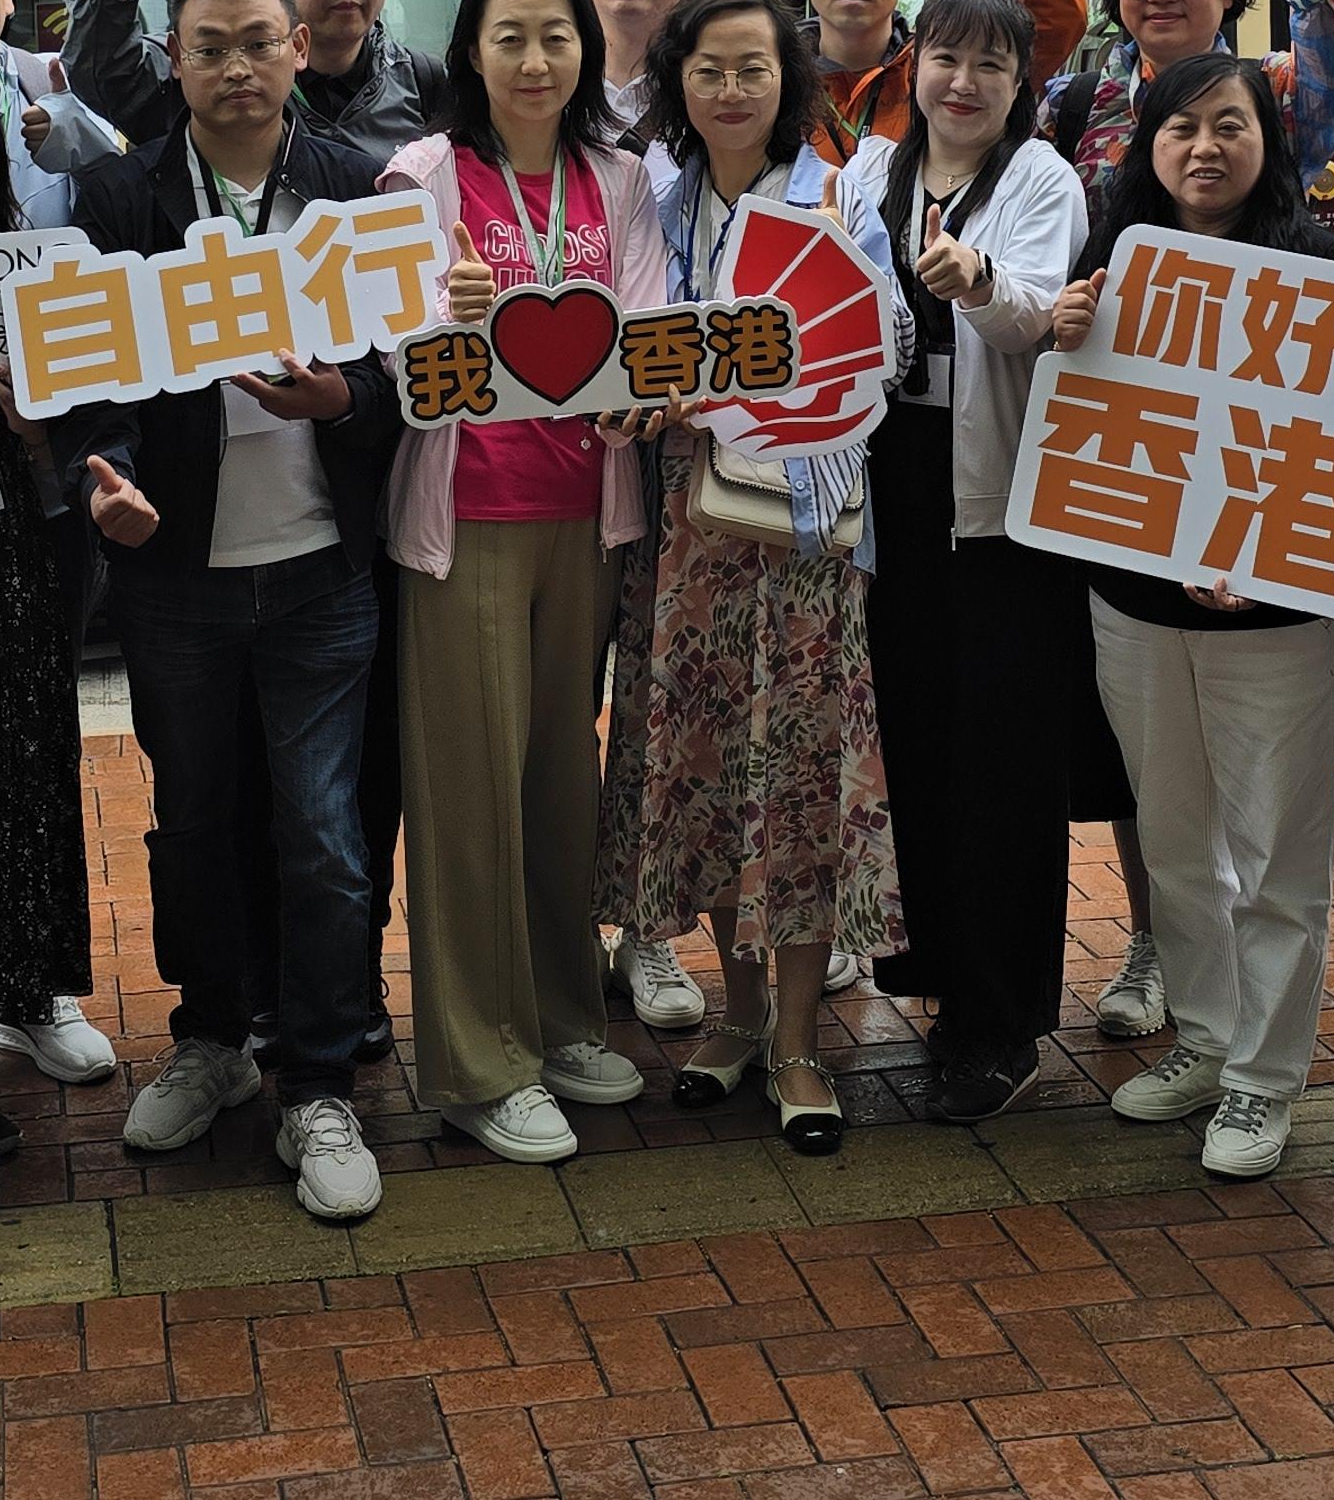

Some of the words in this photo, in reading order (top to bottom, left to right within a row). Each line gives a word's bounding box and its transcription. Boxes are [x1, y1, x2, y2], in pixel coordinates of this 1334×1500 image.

[484, 220, 608, 267] CHOS
[14, 203, 436, 404] 自由行
[401, 332, 497, 420] 我
[620, 302, 796, 397] 香港
